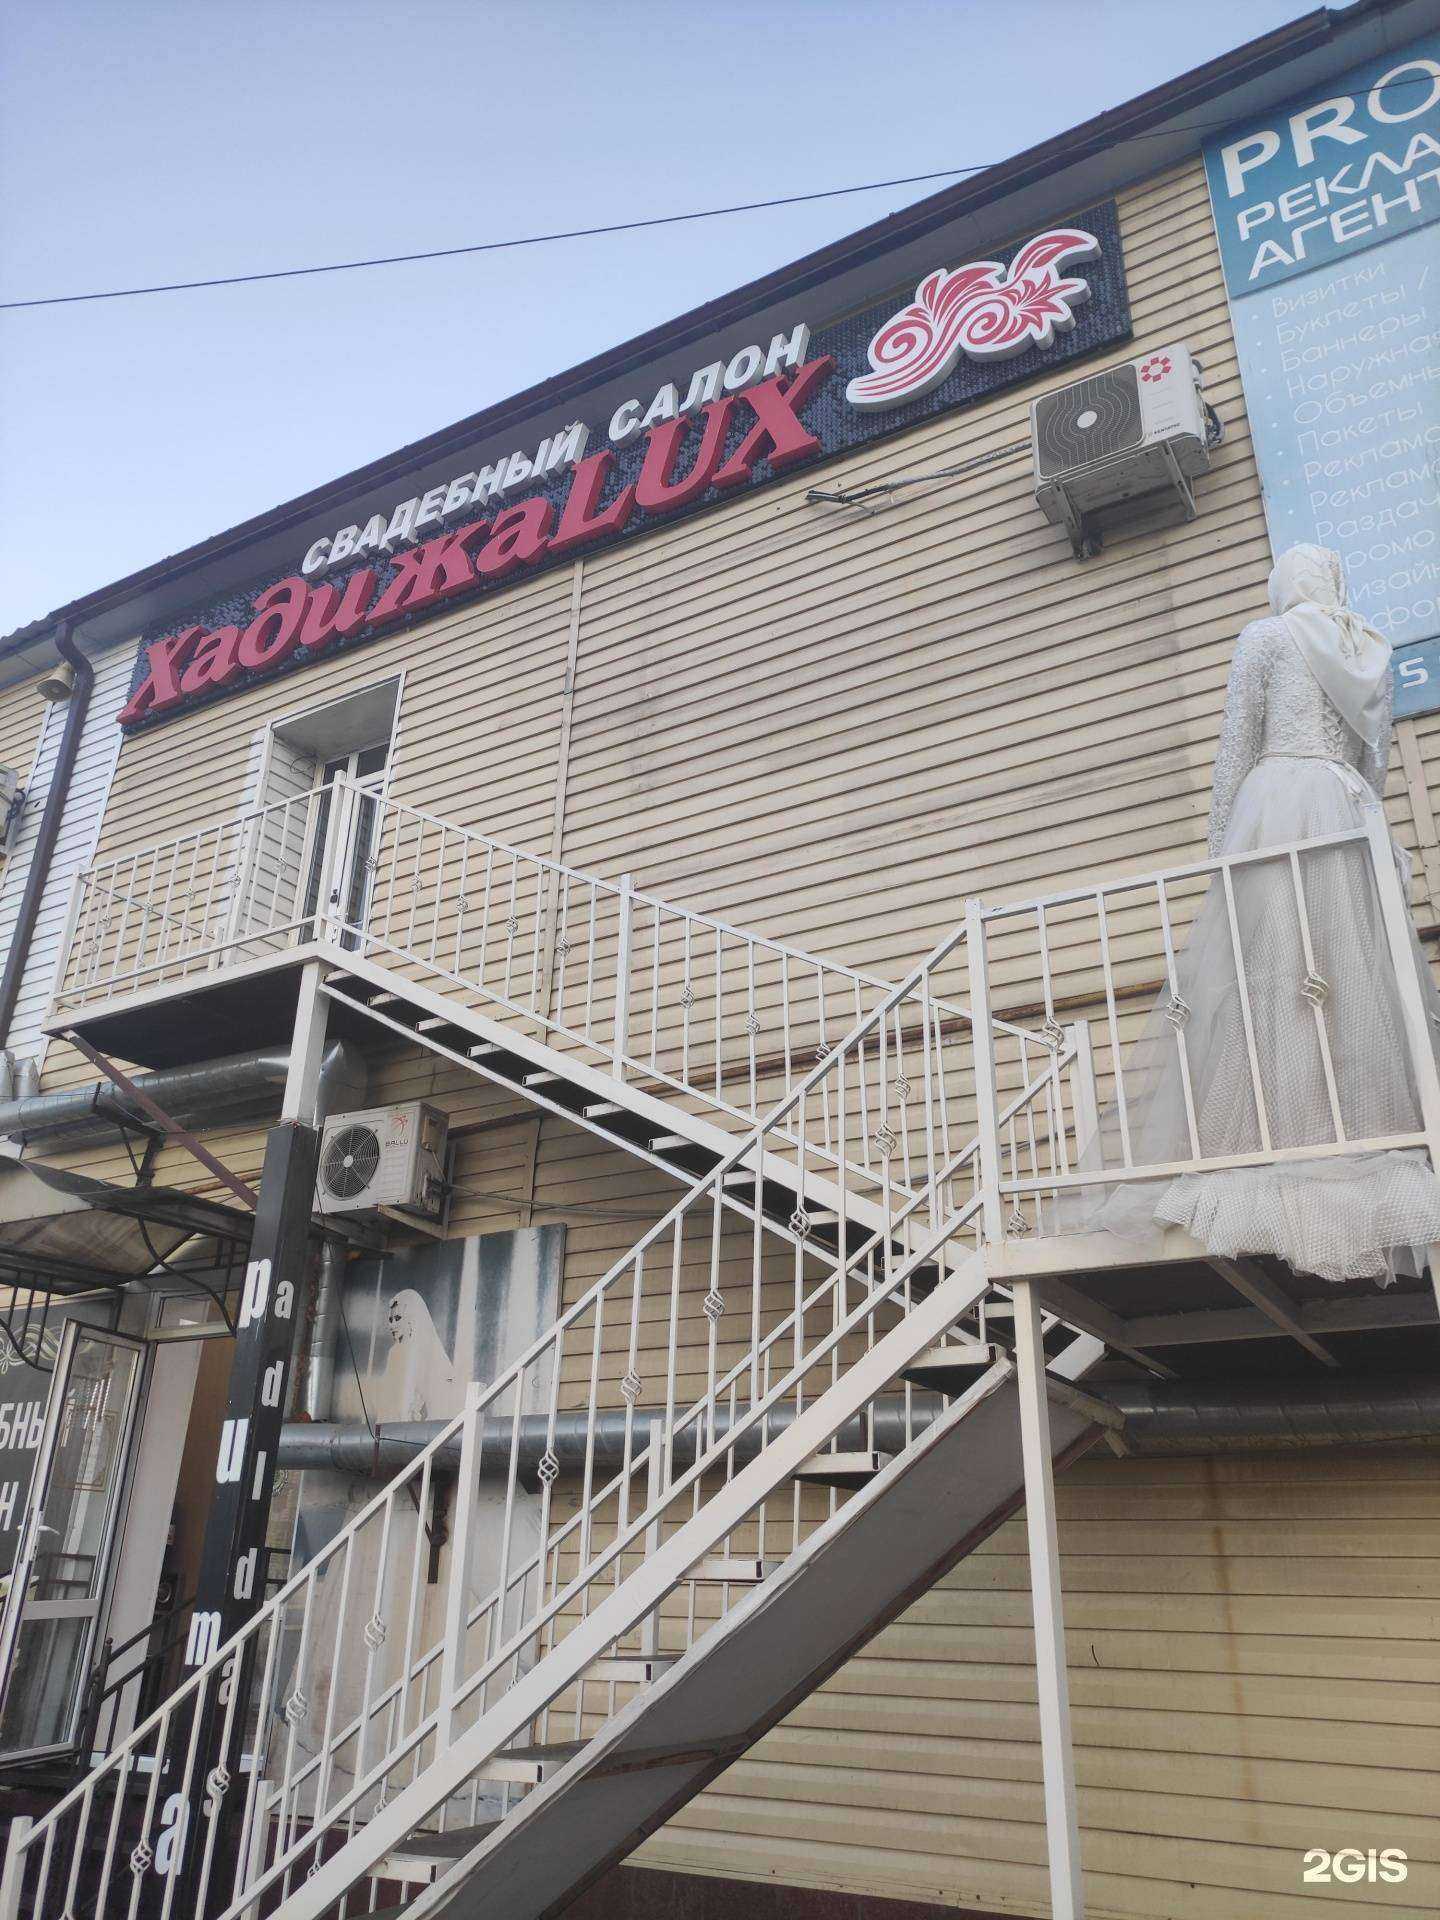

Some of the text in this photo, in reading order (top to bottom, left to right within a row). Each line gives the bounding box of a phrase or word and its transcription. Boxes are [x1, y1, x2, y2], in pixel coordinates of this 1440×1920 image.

[1271, 262, 1386, 318] Визитки
[1276, 284, 1406, 345] Буклеты
[1280, 307, 1427, 372] Баннеры
[301, 322, 811, 579] СВАДЕБНЫЙ САЛОН
[1297, 401, 1425, 456] Пакеты
[1346, 529, 1435, 574] ромо
